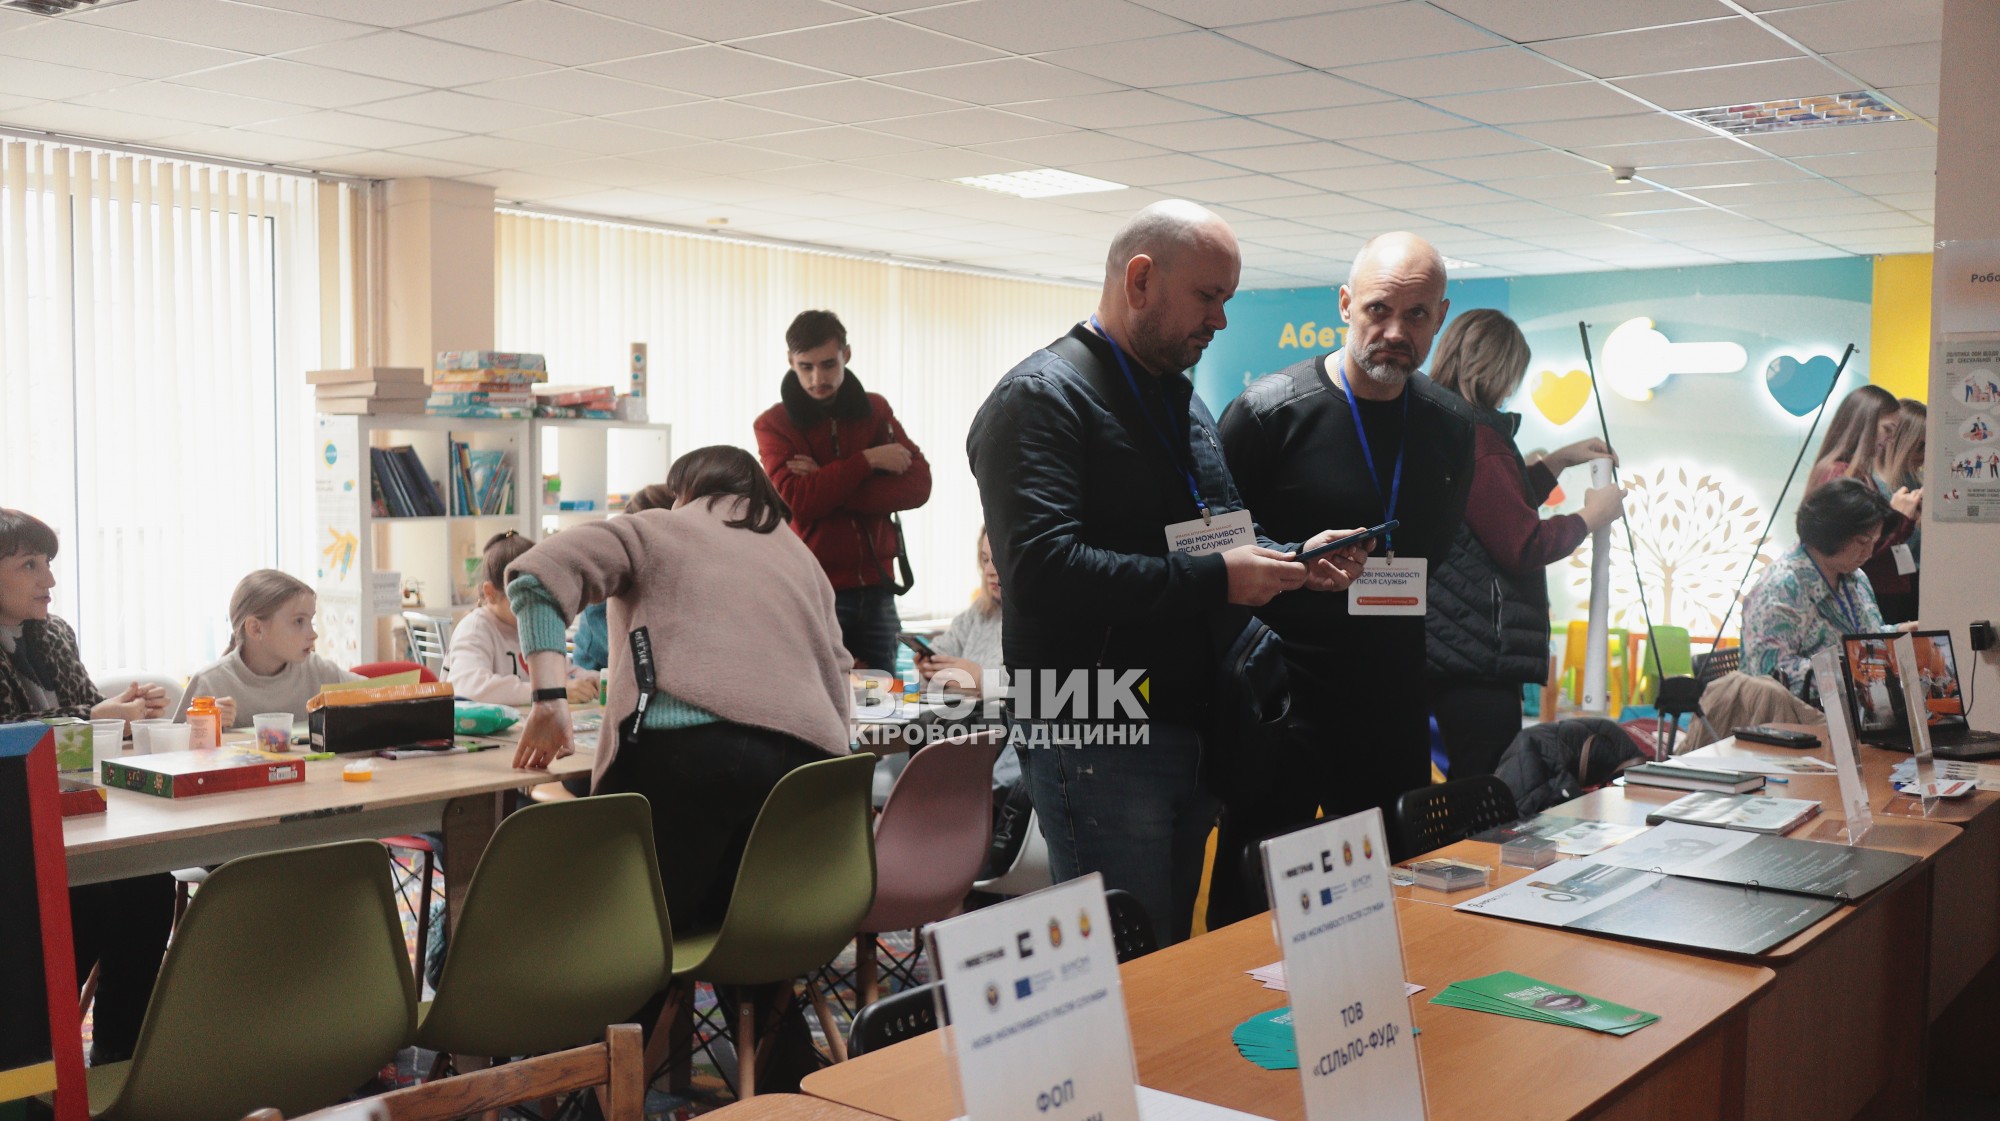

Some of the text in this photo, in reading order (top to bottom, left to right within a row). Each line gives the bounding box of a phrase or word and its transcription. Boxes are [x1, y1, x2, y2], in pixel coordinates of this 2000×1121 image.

[1278, 321, 1348, 349] Абет
[1176, 537, 1195, 547] НОВІ
[1195, 526, 1246, 543] МОЖЛИВОСТІ
[1201, 538, 1234, 551] СЛУЖБИ
[1378, 578, 1407, 586] СЛУЖБИ
[1341, 1002, 1364, 1027] ТОВ
[1313, 1023, 1400, 1077] «СІЛЬПО-ФУД»
[1036, 1079, 1074, 1113] ФОП
